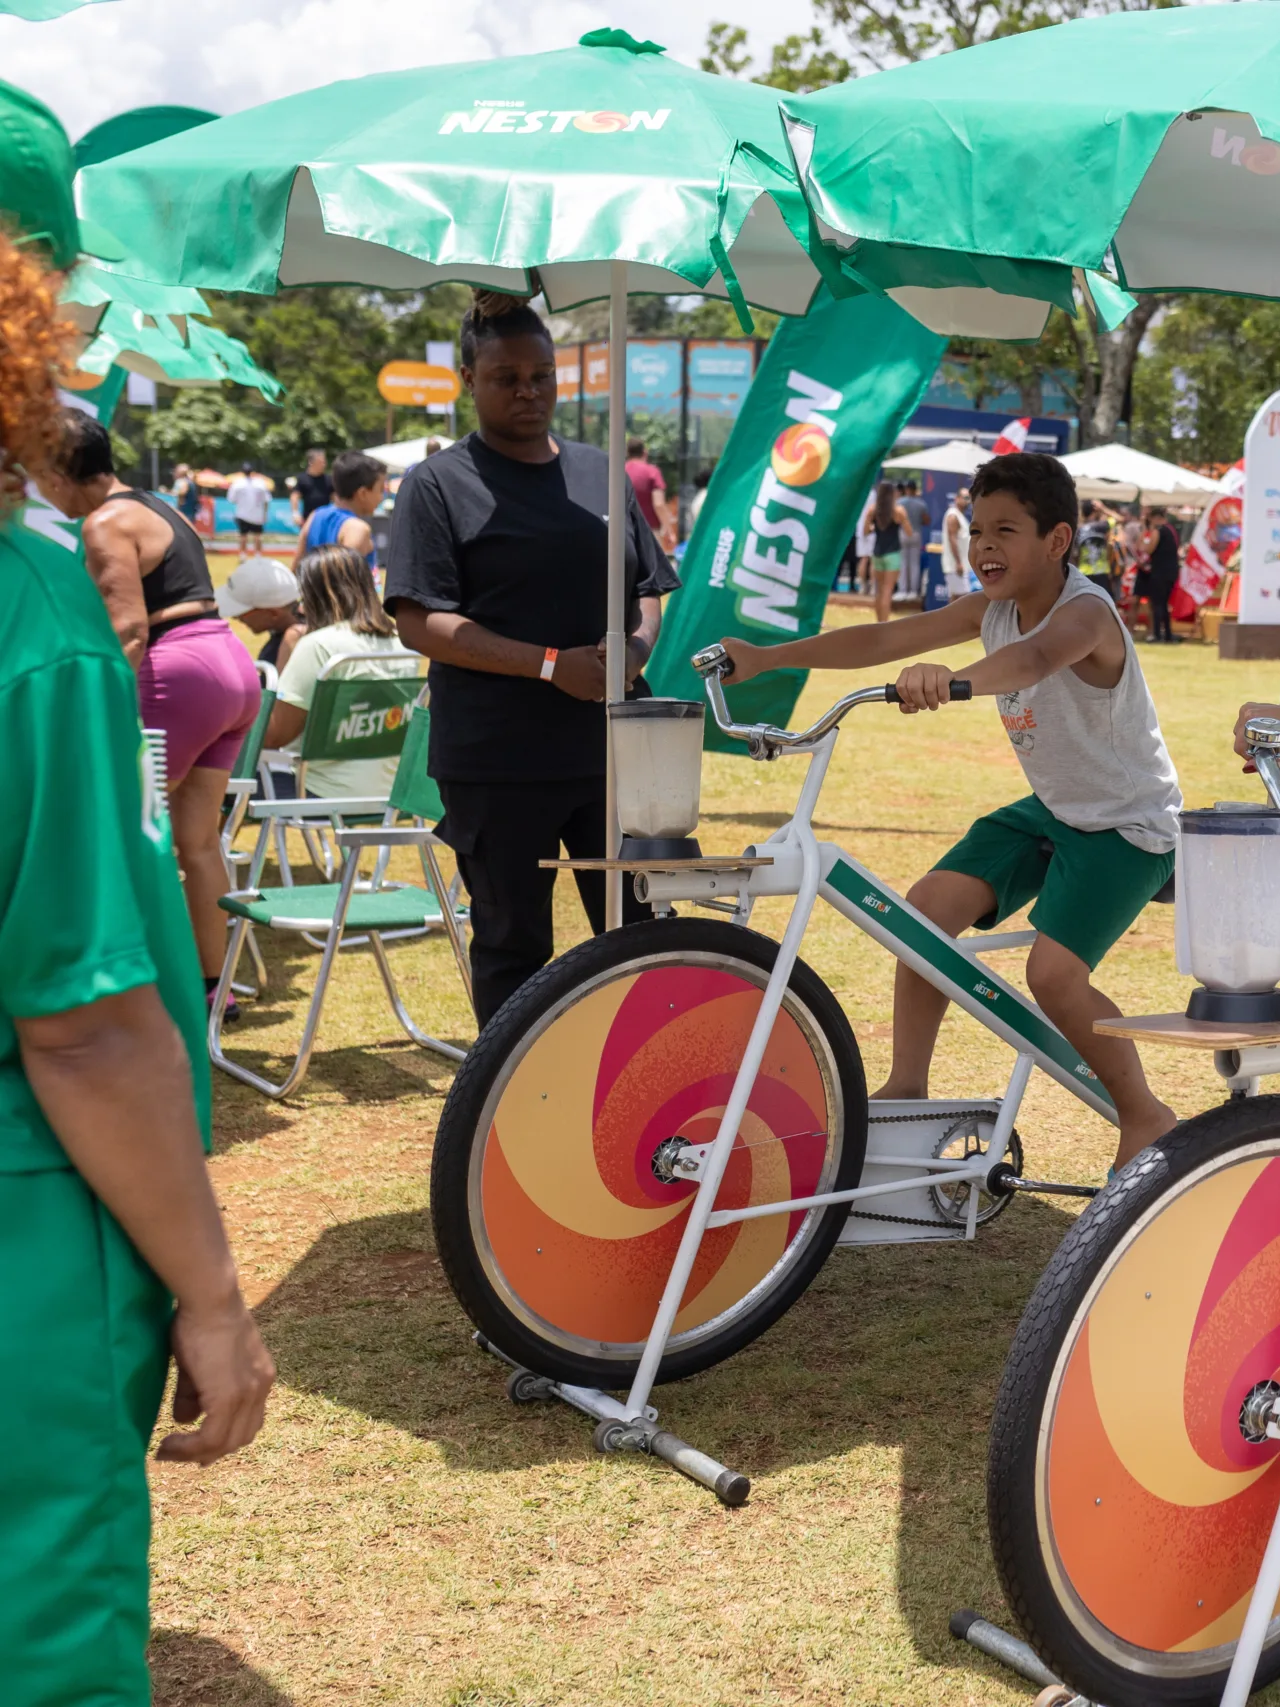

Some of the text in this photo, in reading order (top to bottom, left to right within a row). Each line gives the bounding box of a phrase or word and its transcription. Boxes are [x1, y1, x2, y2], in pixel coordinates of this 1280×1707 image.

[437, 108, 672, 135] NESTON
[732, 370, 843, 633] NESTON
[862, 894, 892, 914] NESTON
[973, 982, 1001, 1001] NESTON
